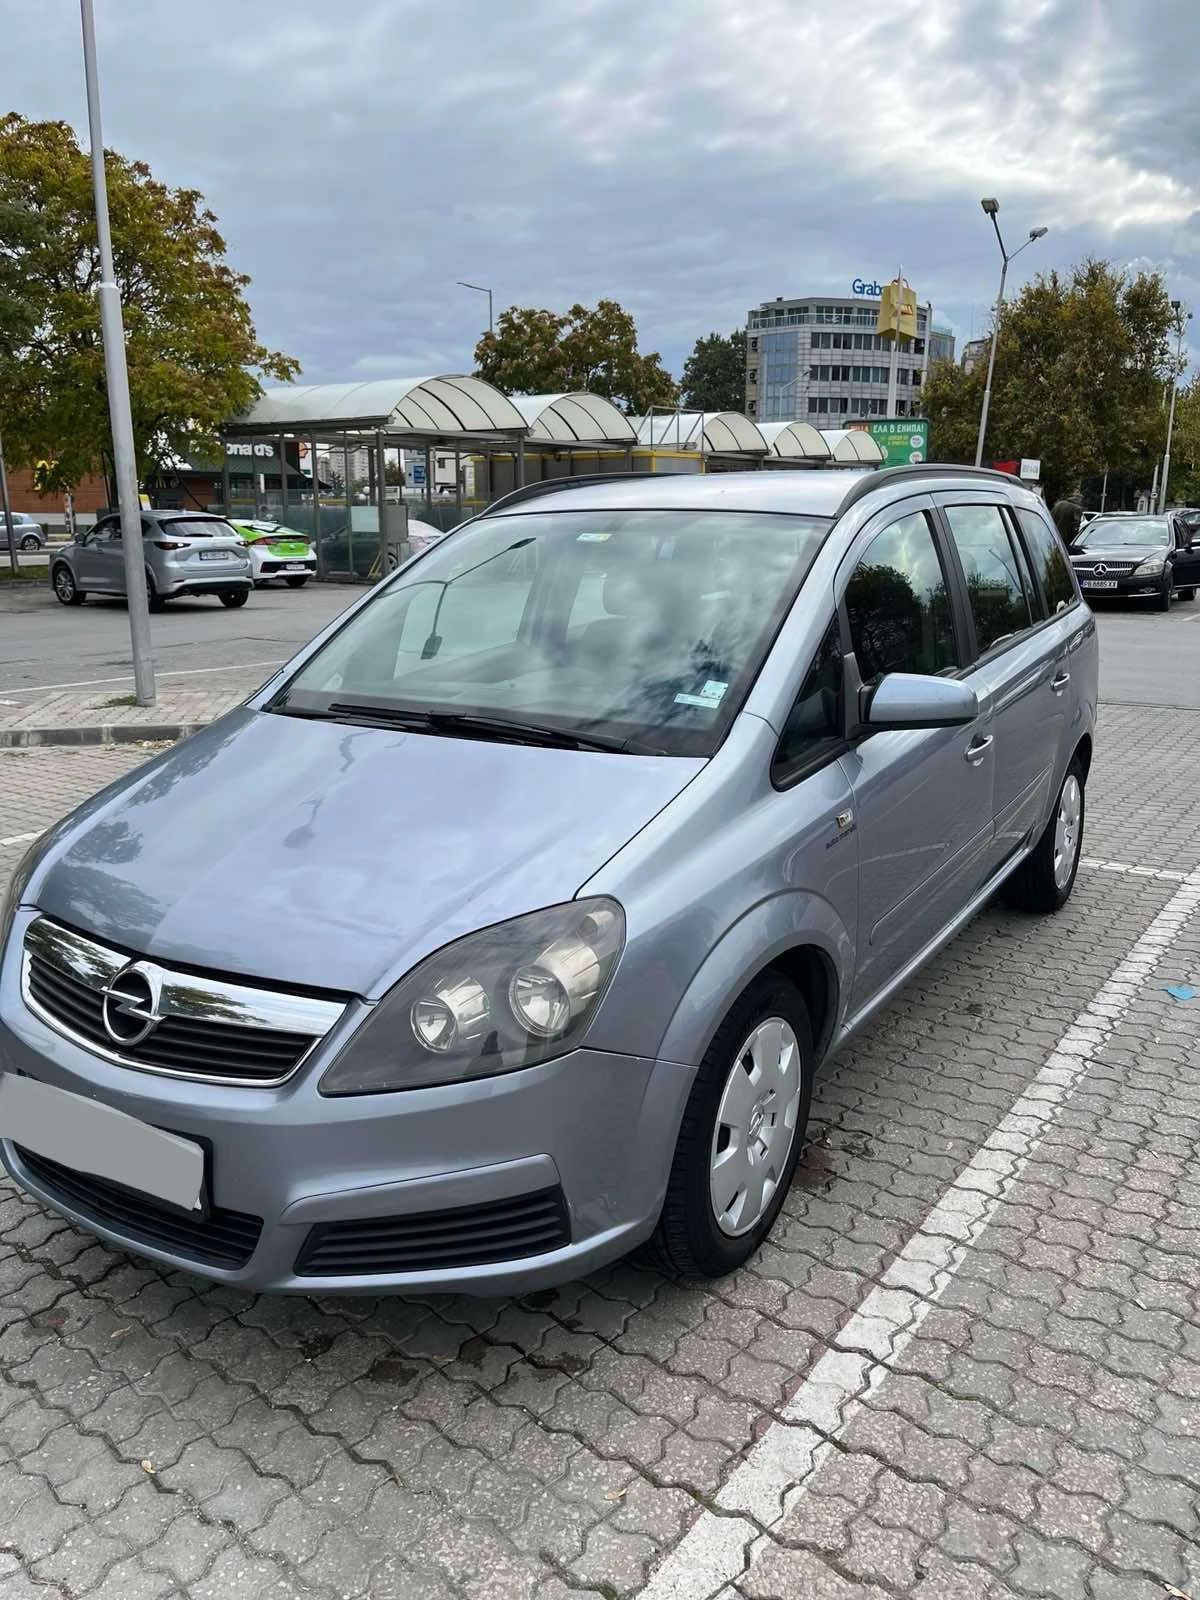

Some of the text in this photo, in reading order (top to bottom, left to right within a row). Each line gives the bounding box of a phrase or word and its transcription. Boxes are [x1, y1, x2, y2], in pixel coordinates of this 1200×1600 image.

[852, 278, 882, 296] Grab
[873, 424, 888, 433] ЕЛА
[897, 423, 924, 433] ЕКИПА!
[226, 443, 275, 457] onald's
